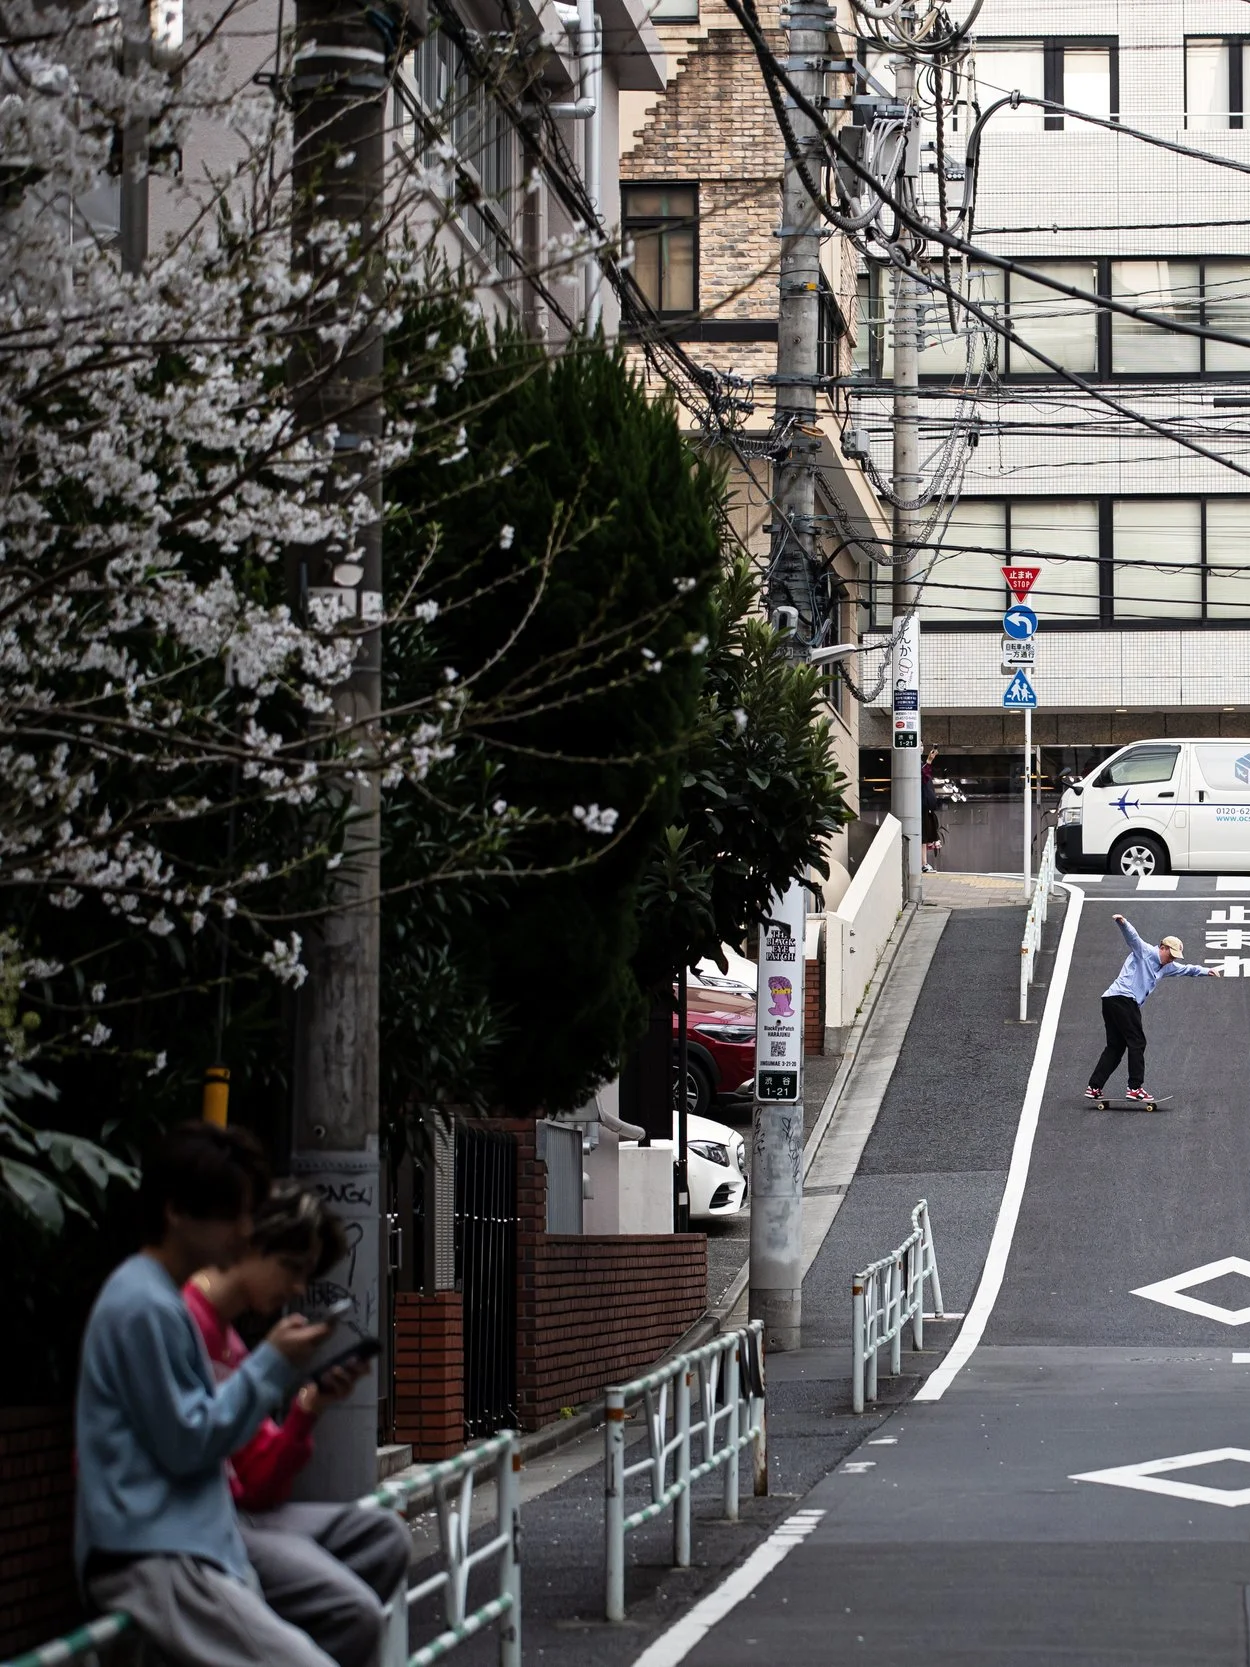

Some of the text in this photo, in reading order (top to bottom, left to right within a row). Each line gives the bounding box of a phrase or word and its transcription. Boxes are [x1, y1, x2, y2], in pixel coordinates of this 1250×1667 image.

[1009, 570, 1034, 579] 止まれ
[1013, 580, 1031, 588] STOP
[1005, 650, 1035, 659] 一方通行
[766, 937, 796, 947] BLACK
[772, 945, 790, 954] EYE
[765, 952, 796, 962] PATCH
[764, 1076, 791, 1086] 渋谷
[766, 1087, 789, 1096] 1-21
